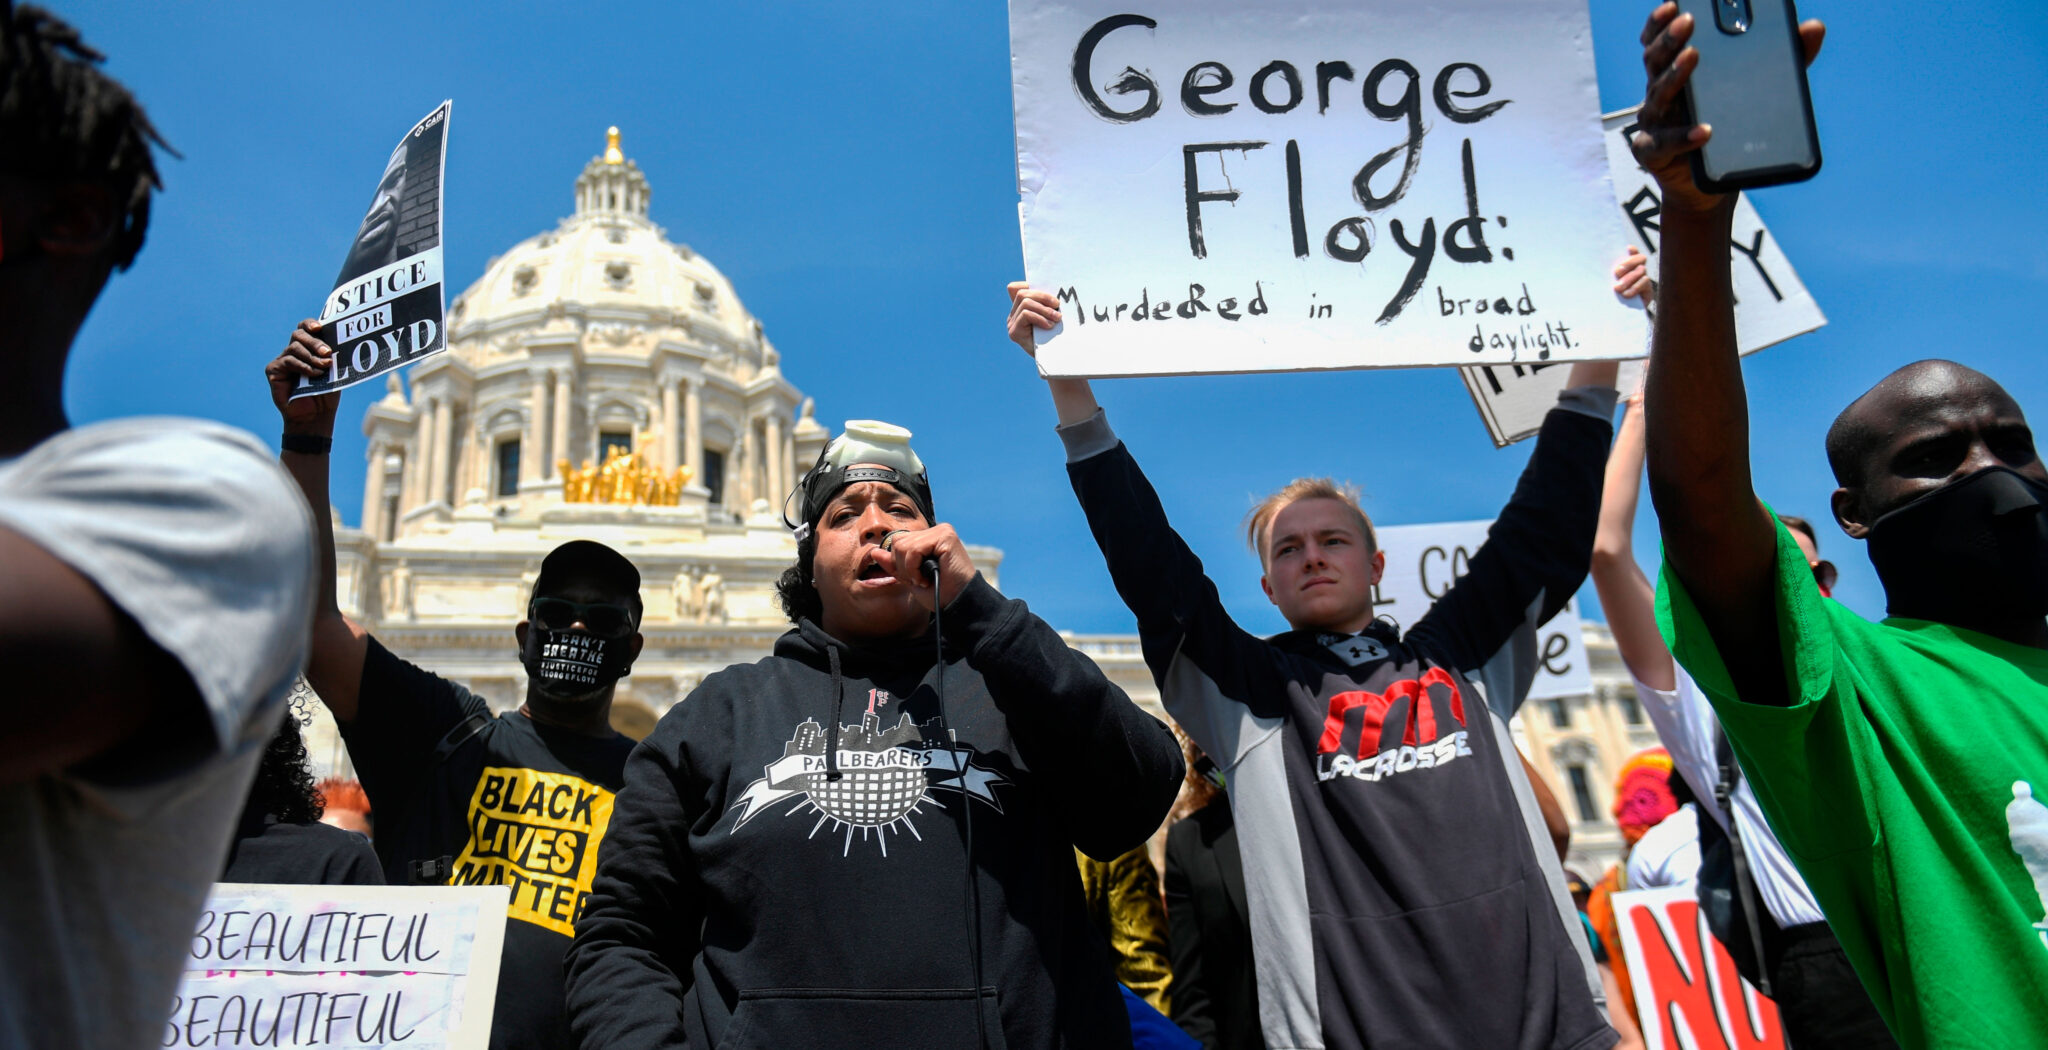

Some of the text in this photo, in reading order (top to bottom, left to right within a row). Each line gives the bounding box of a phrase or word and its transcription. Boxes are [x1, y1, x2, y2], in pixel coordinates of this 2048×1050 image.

[425, 110, 444, 128] CAIR
[1071, 13, 1515, 212] George
[1182, 138, 1515, 325] Floyd:
[320, 260, 427, 322] USTICE
[1309, 292, 1333, 319] in
[1436, 282, 1537, 317] broad
[344, 311, 385, 338] FOR
[1468, 320, 1580, 362] daylight.
[297, 319, 437, 389] LOYD
[542, 643, 605, 665] BREATHE
[560, 633, 606, 652] CAN'T
[803, 749, 933, 772] PALBEARERS
[1316, 731, 1473, 782] LACROSSE
[479, 774, 600, 826] BLACK
[475, 812, 578, 874] LIVES
